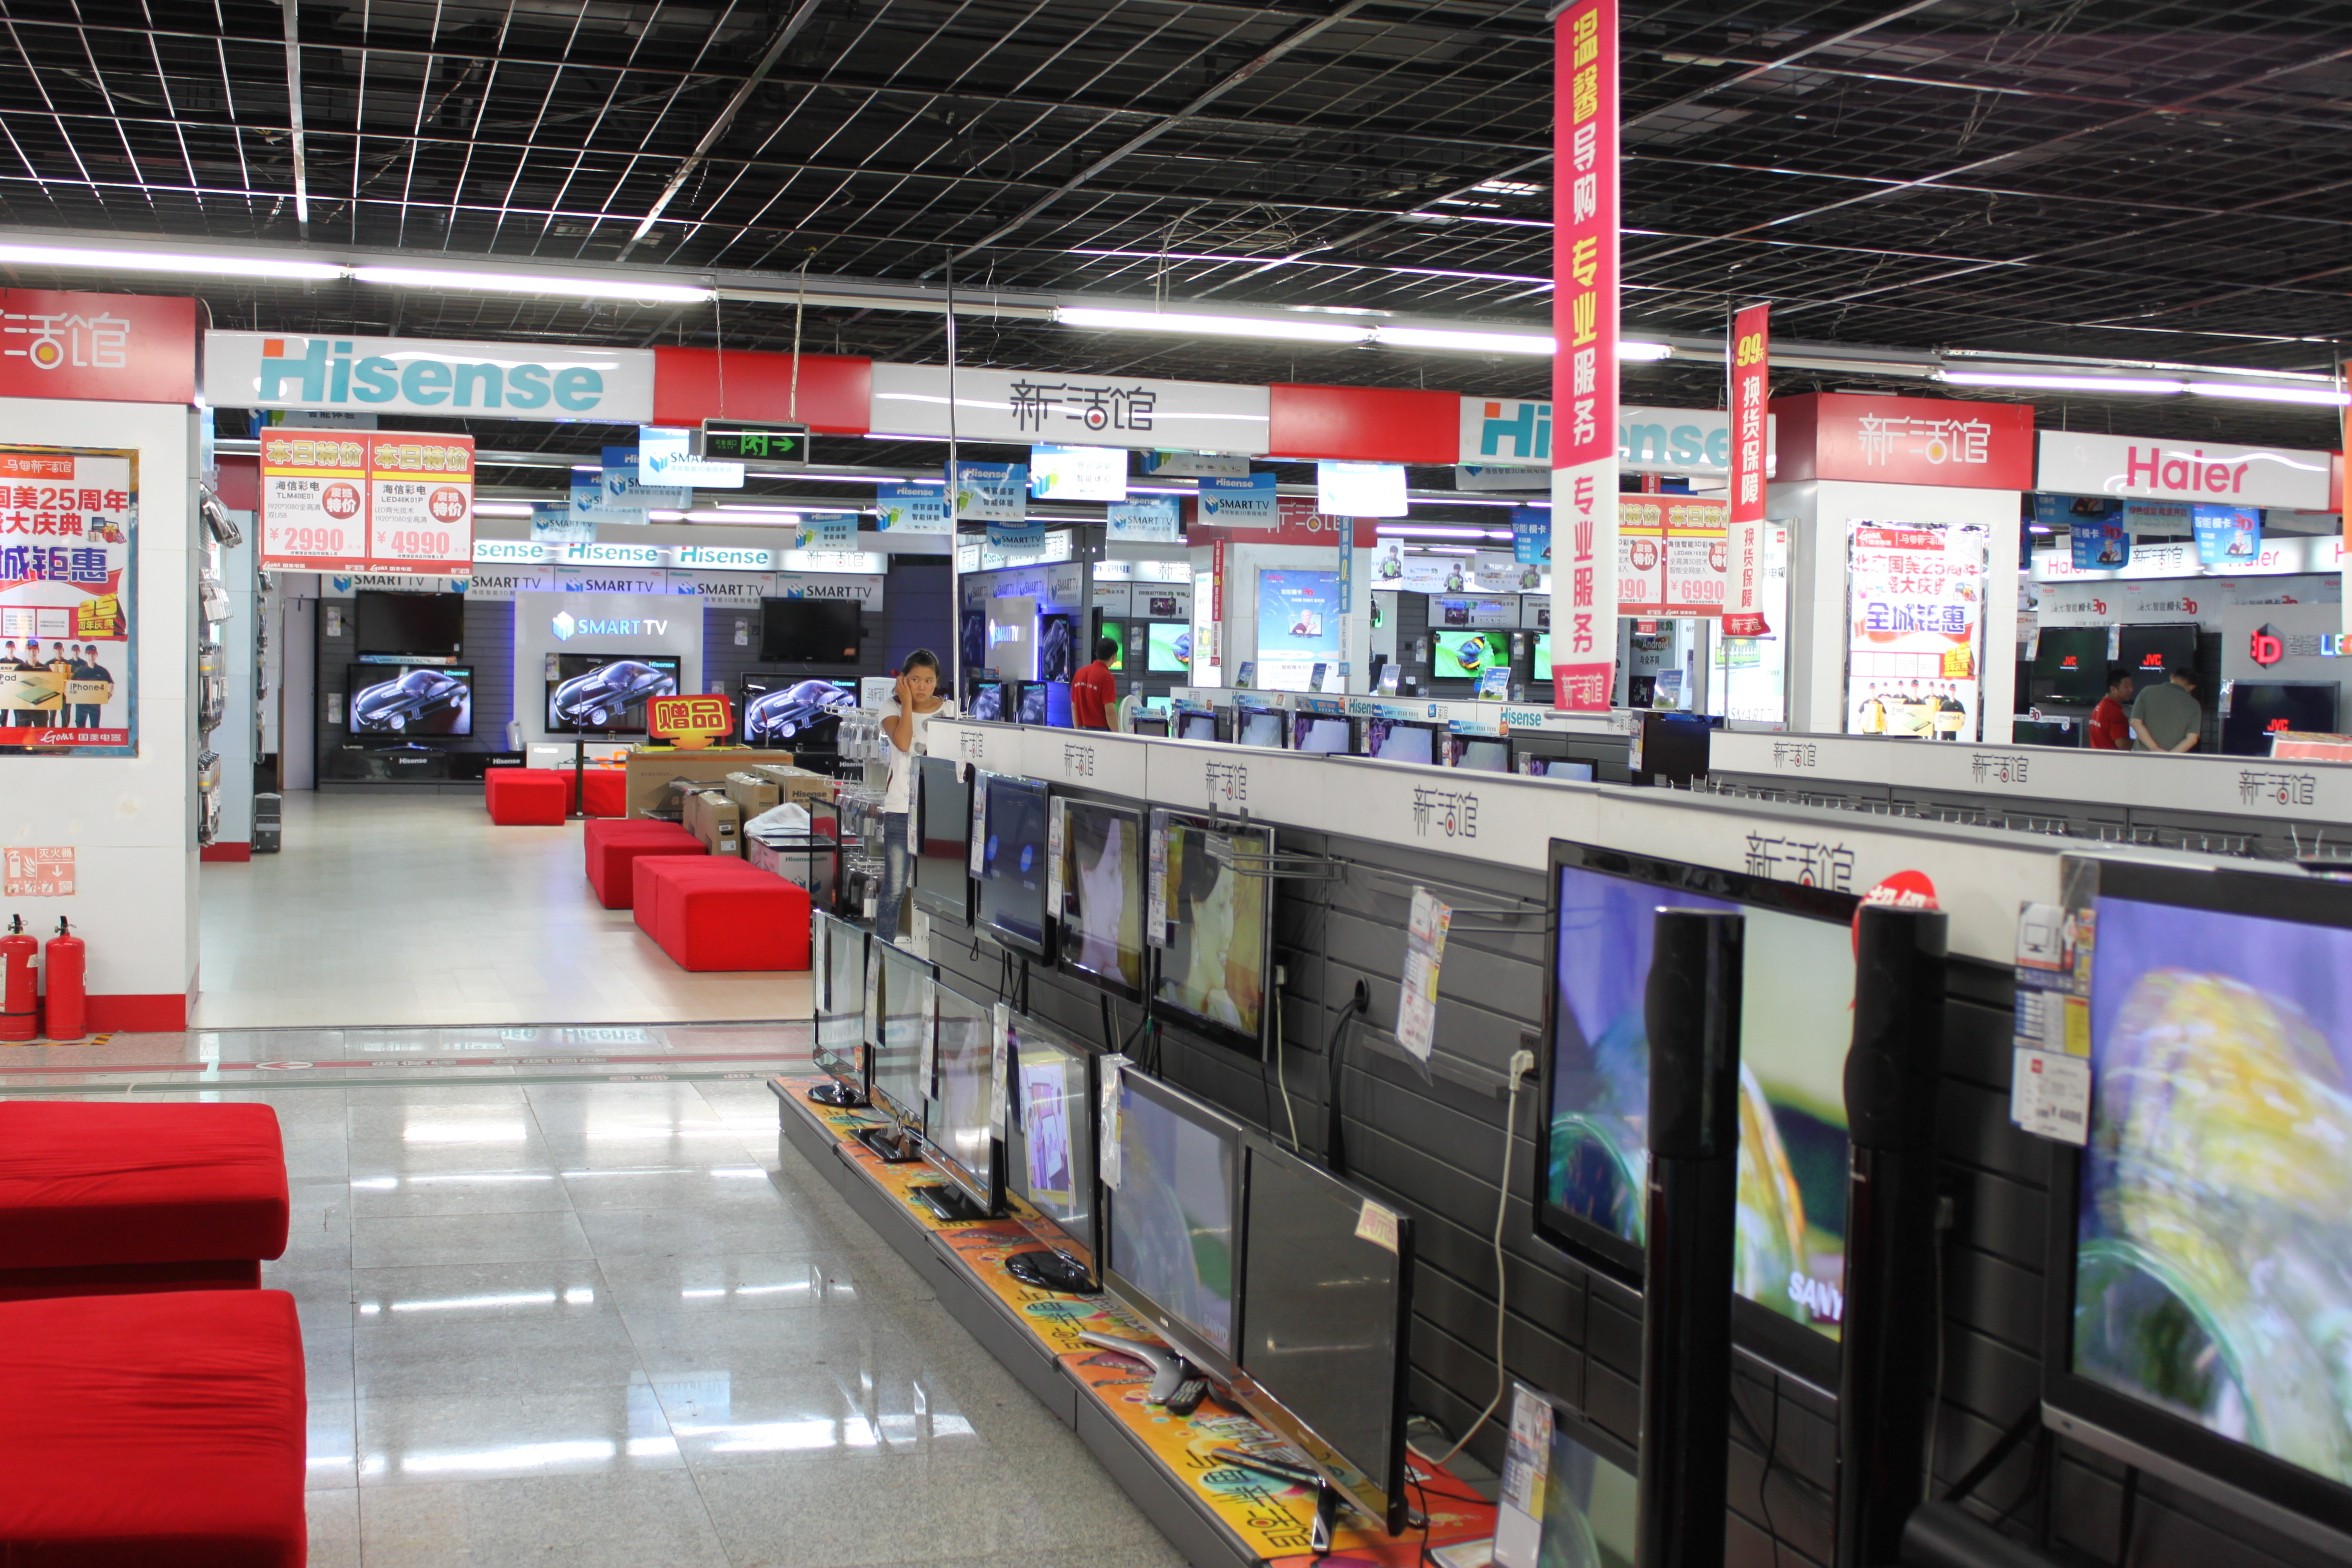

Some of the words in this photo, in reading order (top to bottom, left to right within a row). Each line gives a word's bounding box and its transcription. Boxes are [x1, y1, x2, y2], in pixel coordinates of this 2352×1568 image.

[1573, 8, 1598, 225] 温馨导购
[0, 311, 130, 370] 活馆
[1572, 236, 1598, 446] 专业服务
[258, 339, 604, 411] Hisense
[1010, 378, 1156, 432] 新活馆
[1480, 402, 1728, 466] Hinse
[1741, 376, 1761, 506] 换货保障
[1858, 412, 1991, 466] 新活馆
[266, 439, 364, 467] 本日特价
[374, 444, 470, 471] 本日特价
[2127, 446, 2250, 494] Haier
[275, 480, 320, 491] 海信彩电
[383, 483, 427, 495] 海信彩电
[1216, 477, 1254, 488] Hisense
[327, 498, 357, 513] 特价
[433, 502, 462, 517] 特价
[983, 498, 1014, 507] 智能体验
[1219, 497, 1254, 510] SMART
[1255, 499, 1270, 510] TV
[911, 513, 941, 522] 智能体验
[1127, 514, 1158, 525] SMART
[1619, 504, 1661, 527] 特价
[0, 511, 83, 537] 大庆典
[1512, 523, 1547, 534] 智能模卡
[284, 527, 345, 551] 2990
[391, 531, 450, 554] 4990
[1001, 535, 1028, 544] SMART
[1030, 536, 1041, 544] TV
[477, 543, 544, 558] sense
[568, 543, 658, 562] Hisense
[680, 546, 769, 565] Hisense
[1573, 476, 1594, 653] 专业服务
[1633, 553, 1655, 567] 特价
[1741, 528, 1755, 608] 换货保障
[472, 575, 519, 589] SMART
[523, 577, 541, 589] TV
[586, 579, 633, 593] SMART
[636, 580, 654, 592] TV
[697, 583, 744, 596] SMART
[746, 585, 764, 597] TV
[806, 585, 852, 598] SMART
[854, 587, 872, 598] TV
[1681, 580, 1725, 600] 6990
[578, 619, 641, 636] SMART
[643, 620, 668, 636] TV
[1642, 636, 1669, 650] Android
[648, 660, 676, 669] Hisense
[1640, 655, 1660, 666] 与众不同
[2062, 656, 2078, 666] JVC
[2143, 654, 2163, 666] JVC
[444, 669, 470, 678] Hisense
[656, 700, 725, 730] 赠品
[1501, 707, 1541, 727] Hisense
[2267, 719, 2289, 731] JVC
[399, 757, 428, 765] Hisense
[493, 757, 521, 765] Hisense
[1206, 759, 1248, 801] 新活馆
[792, 790, 827, 798] Hisense
[1414, 785, 1479, 839] 新活馆
[39, 848, 73, 858] 灭火器
